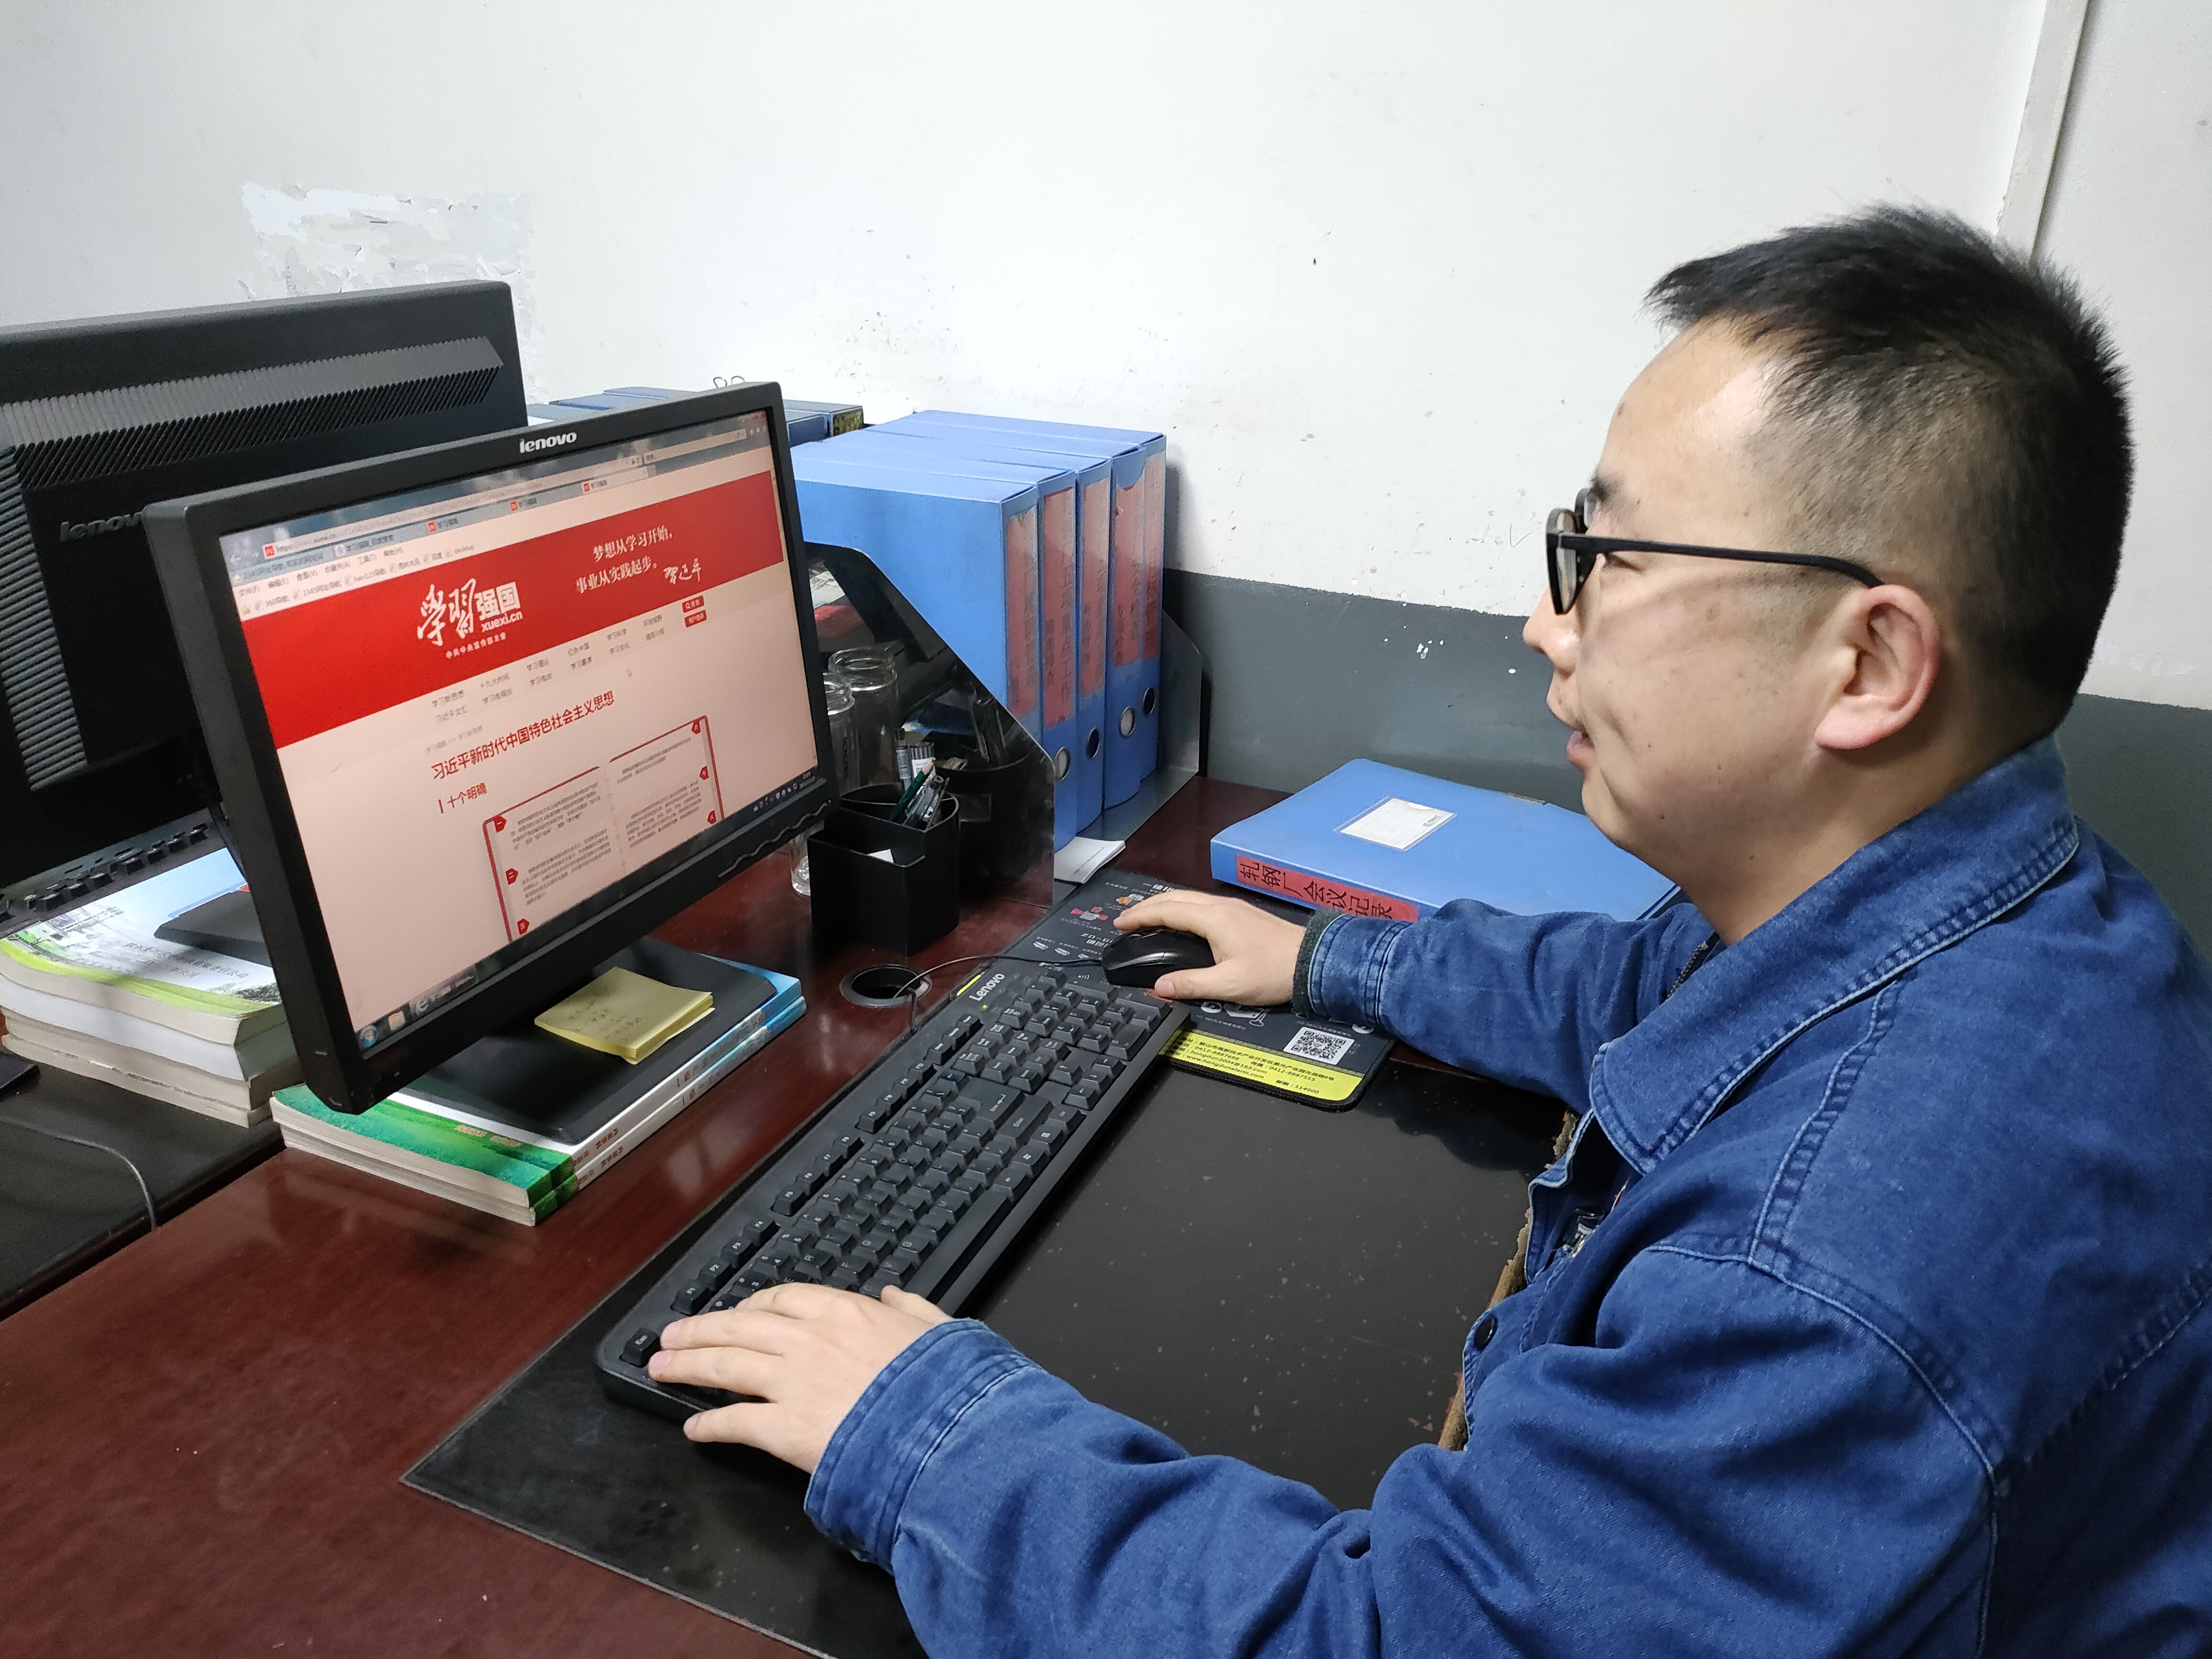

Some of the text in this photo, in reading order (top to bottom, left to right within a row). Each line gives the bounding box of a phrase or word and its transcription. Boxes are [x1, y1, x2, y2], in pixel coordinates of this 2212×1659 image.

[520, 432, 577, 453] lenovo
[60, 511, 144, 543] lenov
[481, 611, 523, 632] xuexi.cn
[431, 691, 615, 780] 习近平新时代中国特色社会主义思想
[447, 782, 487, 809] 十个明确
[969, 973, 1005, 1001] Lenovo
